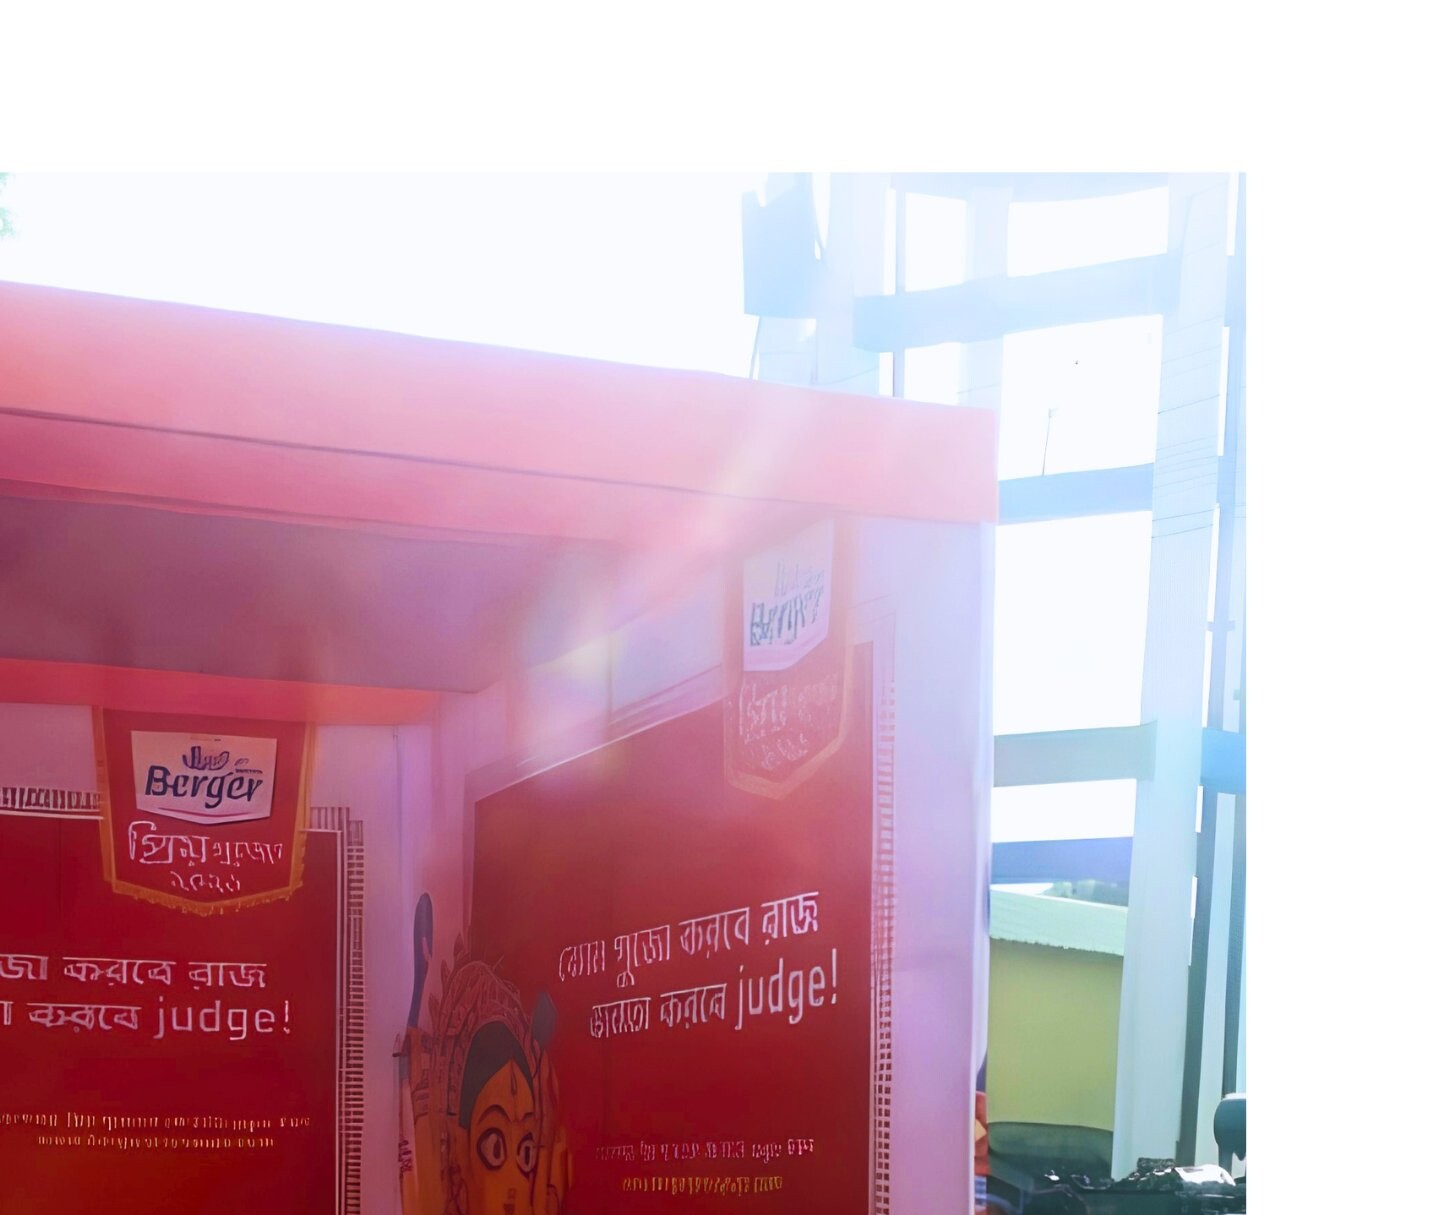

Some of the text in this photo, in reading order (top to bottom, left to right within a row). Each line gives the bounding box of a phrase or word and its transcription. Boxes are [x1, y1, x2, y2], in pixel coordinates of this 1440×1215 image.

[144, 765, 264, 809] Berger
[188, 962, 268, 990] রাজ
[734, 948, 838, 1031] judge!
[153, 996, 291, 1041] judge!
